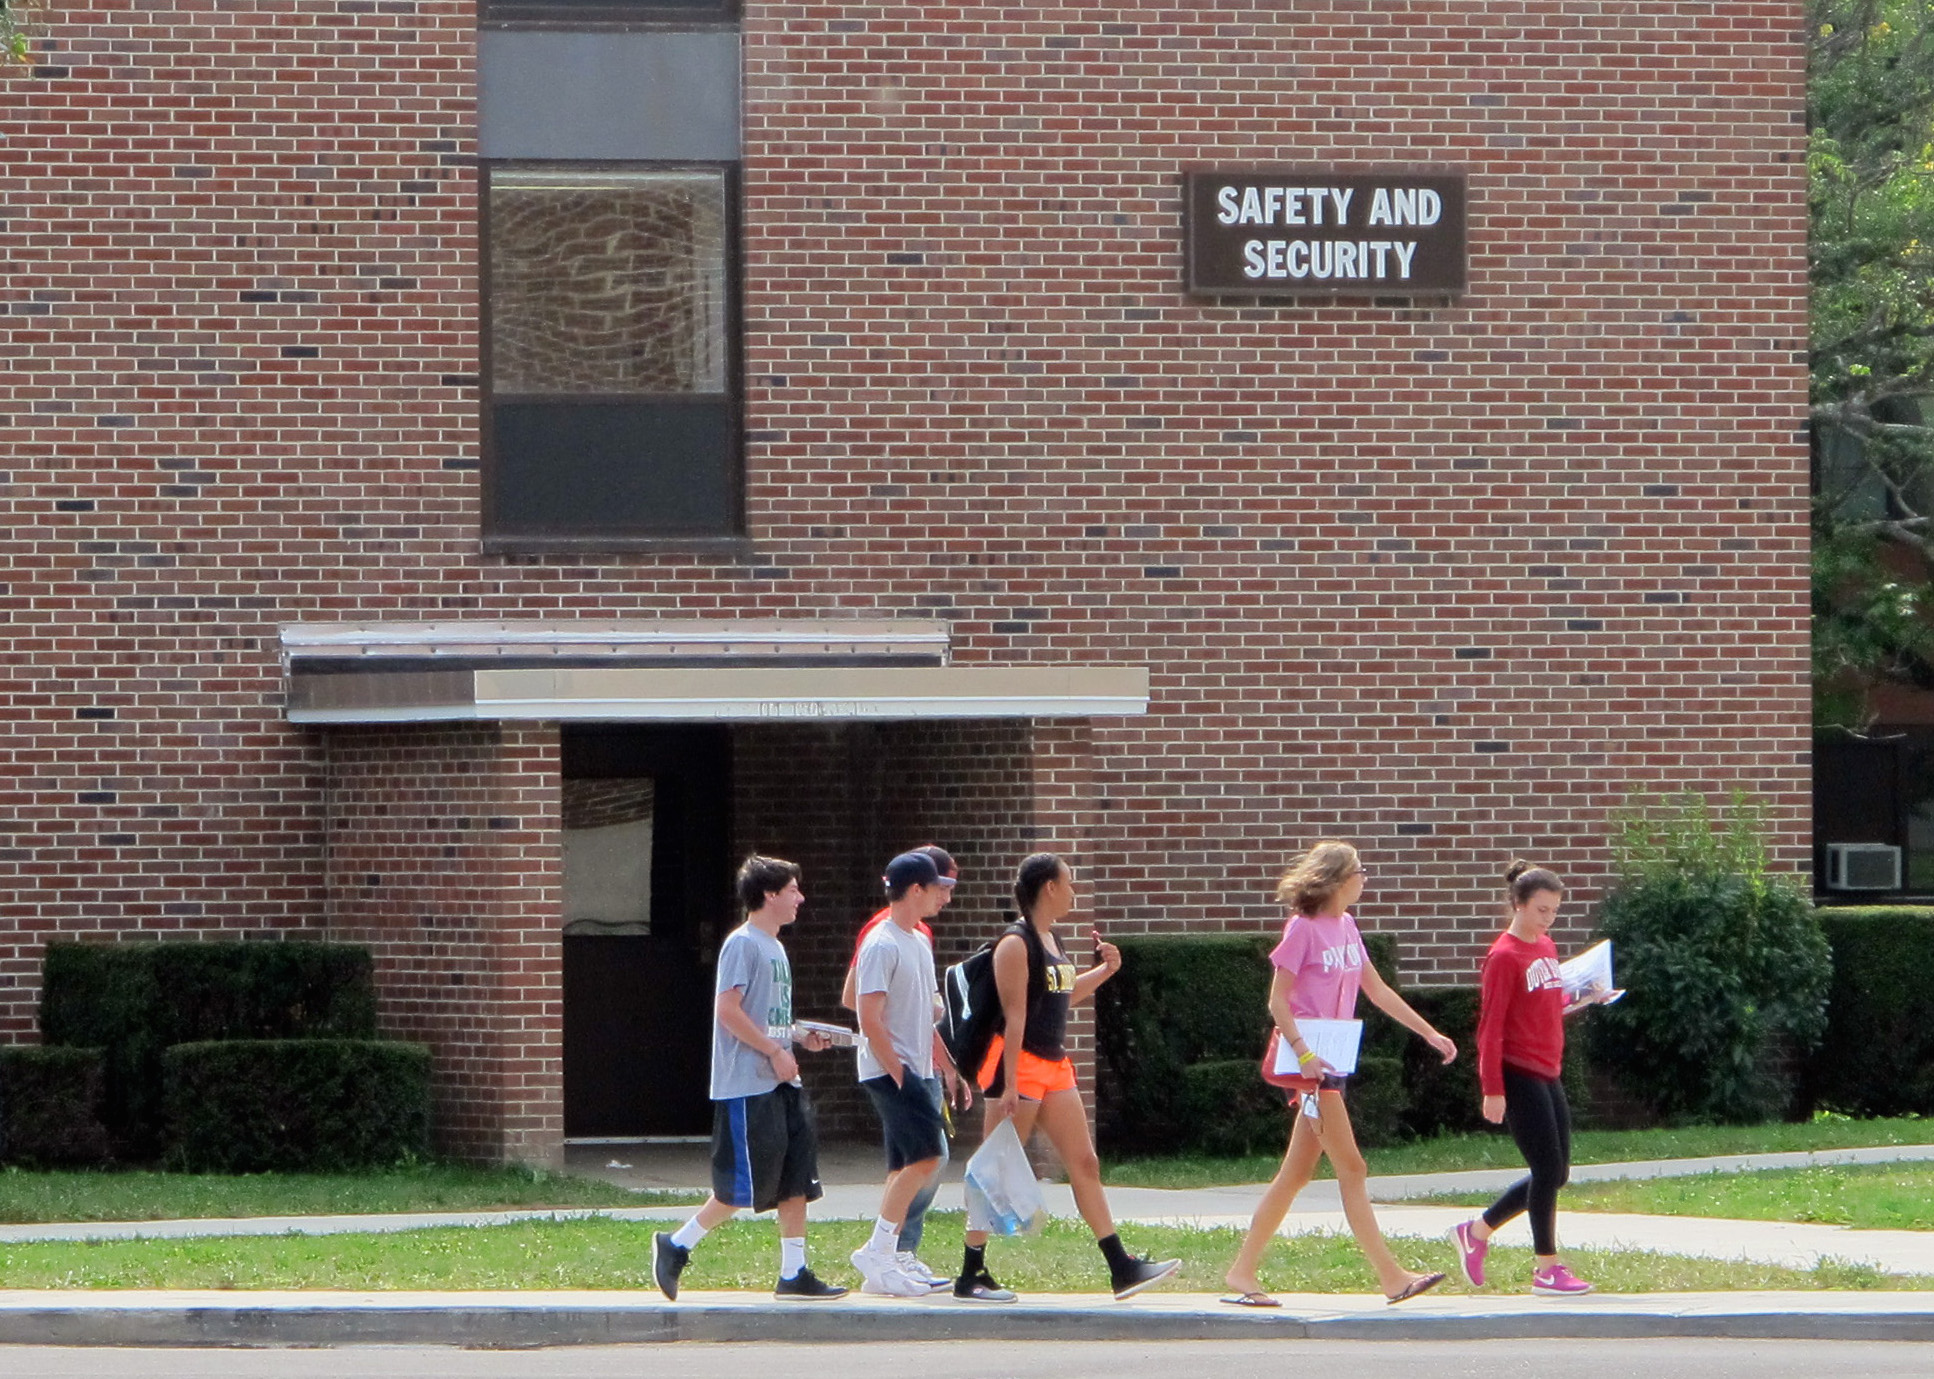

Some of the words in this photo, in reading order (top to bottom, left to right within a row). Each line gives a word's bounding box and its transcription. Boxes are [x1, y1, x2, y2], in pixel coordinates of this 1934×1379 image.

[1217, 186, 1354, 225] SAFETY
[1368, 187, 1442, 226] AND
[1244, 240, 1418, 279] SECURITY
